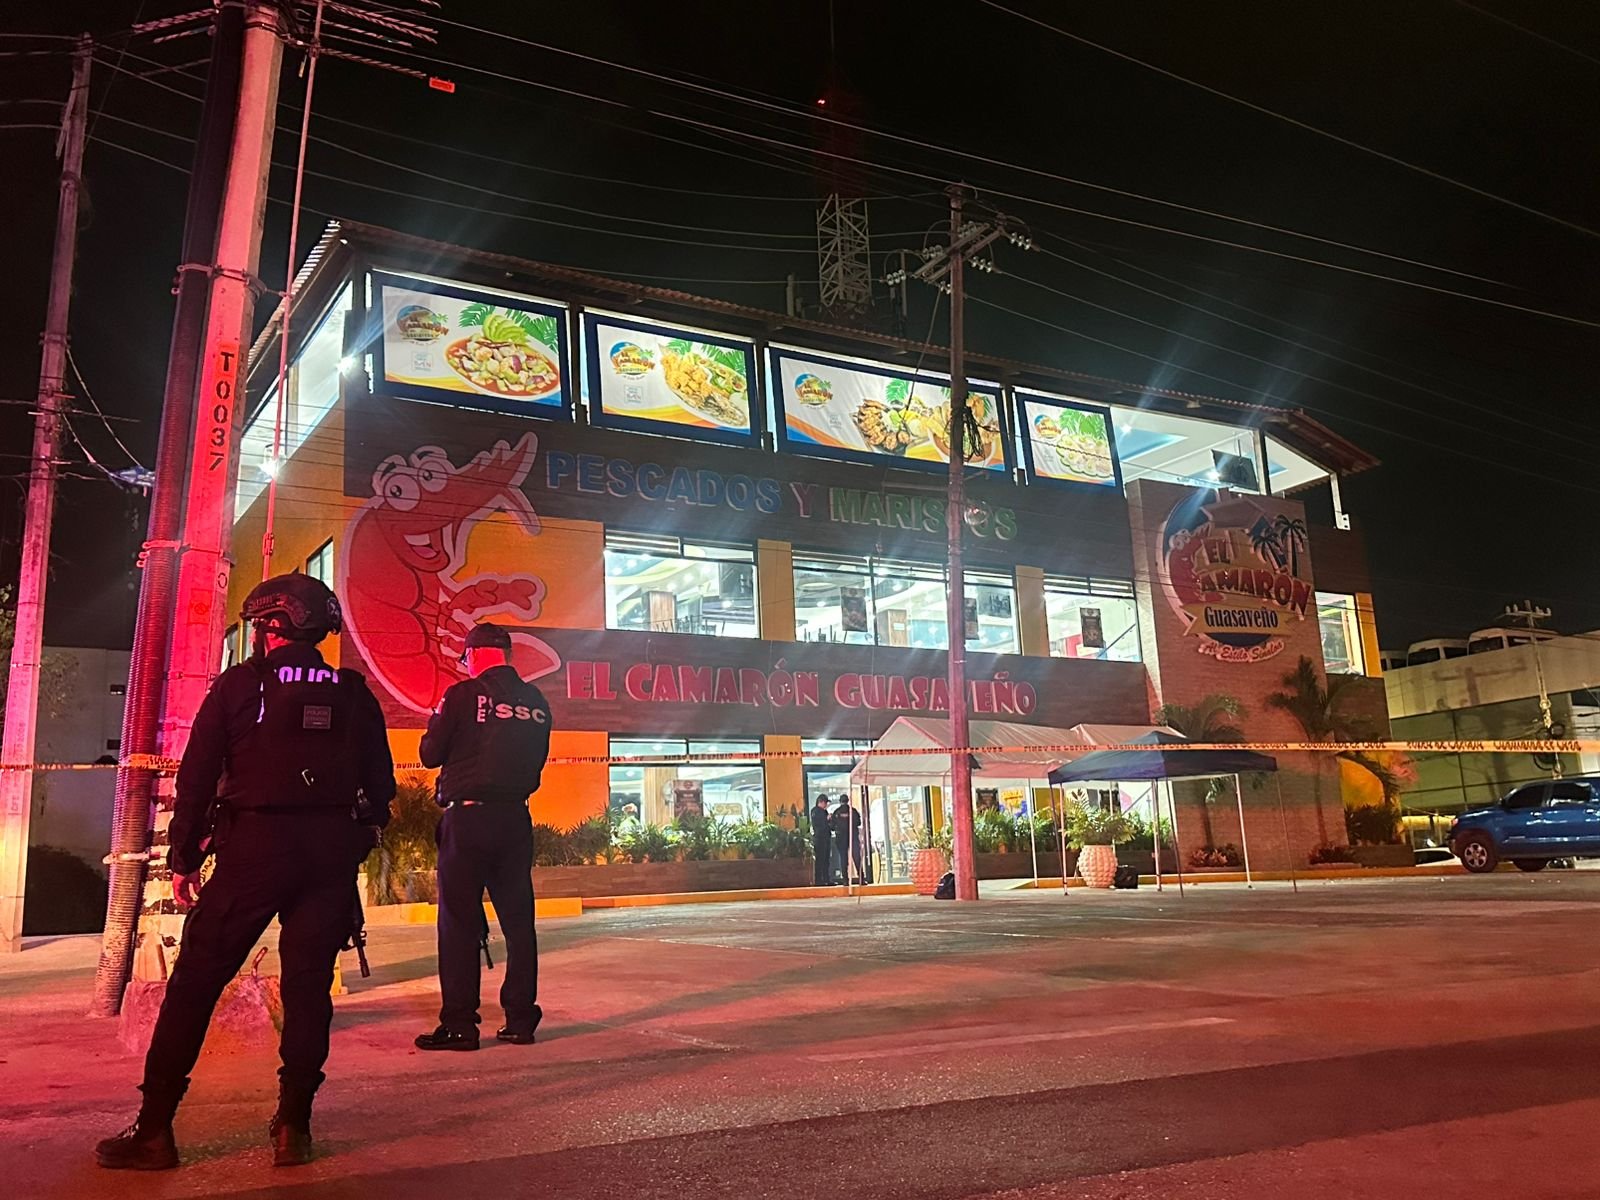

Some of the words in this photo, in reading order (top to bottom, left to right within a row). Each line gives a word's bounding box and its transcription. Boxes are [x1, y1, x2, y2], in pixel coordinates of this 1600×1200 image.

[546, 451, 783, 514] PESCADOS
[789, 481, 820, 519] Y
[829, 486, 1018, 541] MARISOS
[1201, 537, 1232, 565] EL
[1204, 606, 1279, 628] Guasaveño
[566, 661, 617, 700] EL
[625, 657, 820, 707] CAMARÓN
[834, 671, 1037, 716] GUASAEÑO
[495, 703, 547, 724] SSC
